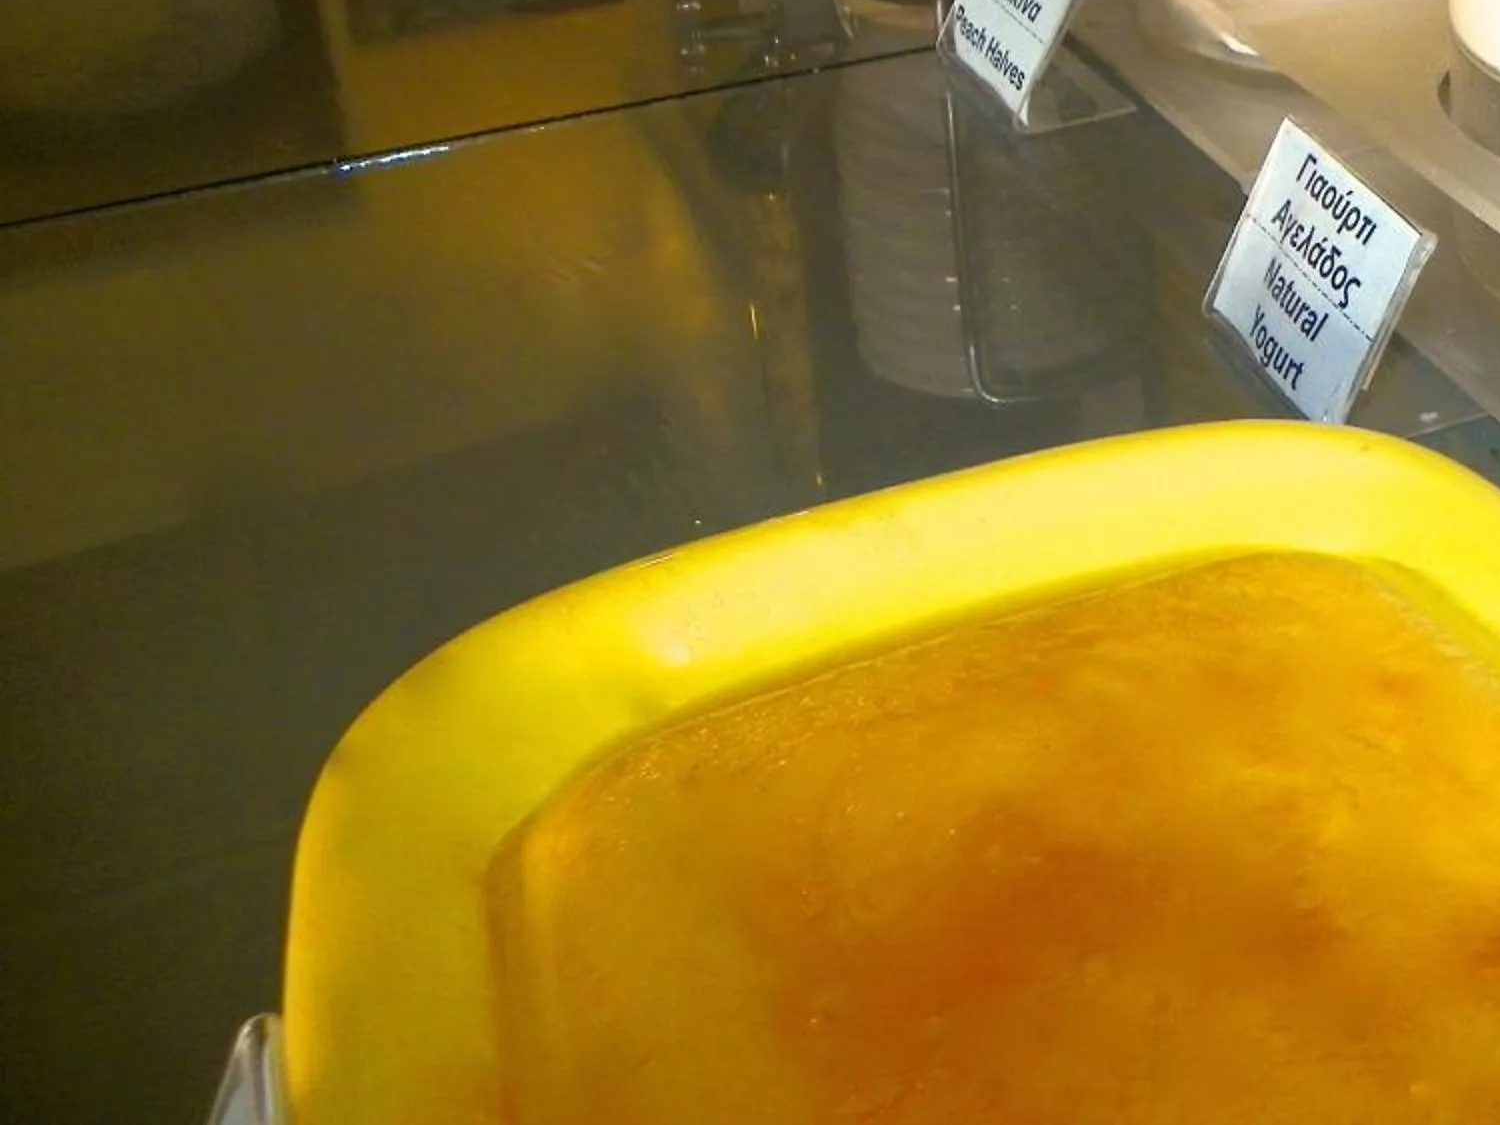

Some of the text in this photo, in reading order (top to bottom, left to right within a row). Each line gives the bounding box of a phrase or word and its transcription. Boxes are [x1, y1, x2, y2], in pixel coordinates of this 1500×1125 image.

[955, 5, 1026, 91] Peach Halves
[1296, 154, 1377, 246] Γιαούρτι
[1271, 199, 1361, 309] Αγελάδος
[1264, 259, 1329, 341] Natural
[1249, 304, 1304, 390] Yogurt
